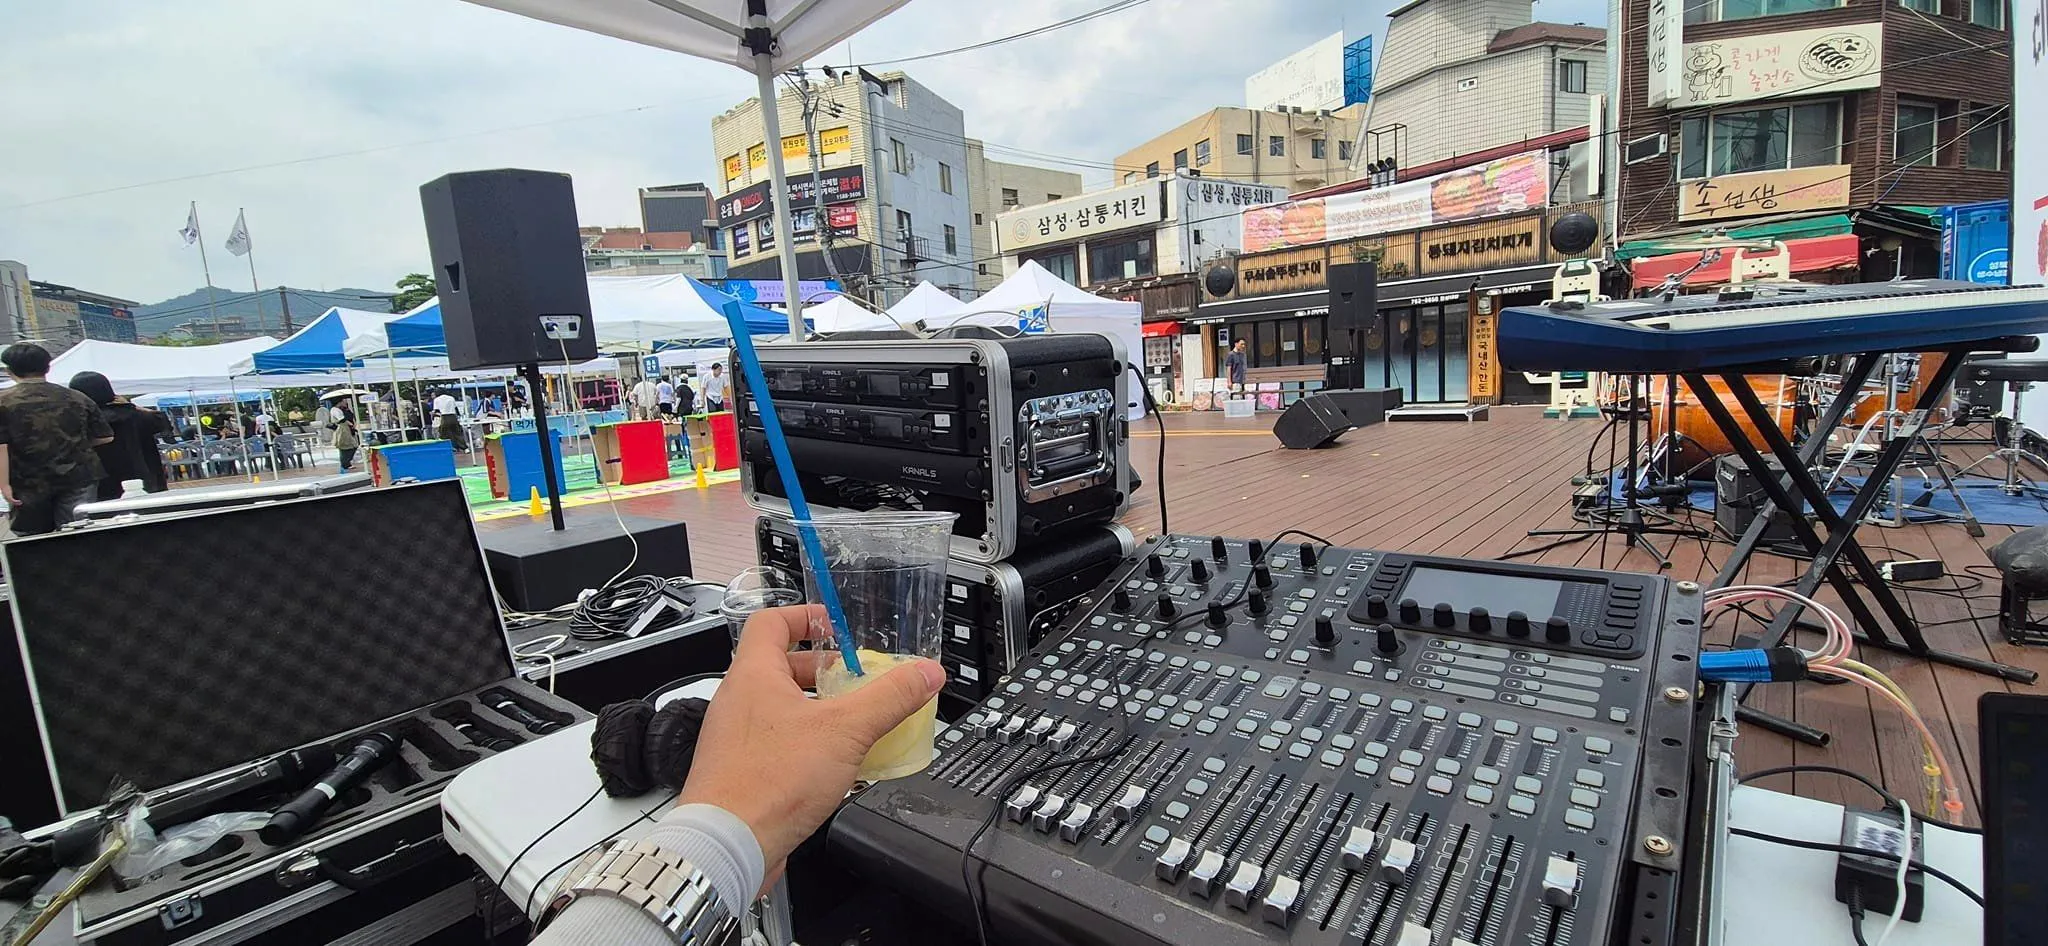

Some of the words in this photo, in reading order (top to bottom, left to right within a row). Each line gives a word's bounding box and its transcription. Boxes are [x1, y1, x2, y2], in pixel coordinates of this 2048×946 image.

[1731, 45, 1781, 71] 콜라겐
[1750, 69, 1795, 93] 충전소
[720, 203, 733, 219] 온골
[902, 466, 937, 478] KANALS
[1610, 664, 1640, 672] ASSIGN
[1569, 781, 1590, 790] CLEAR
[1510, 811, 1528, 819] MUTE
[1568, 826, 1587, 834] MUTE
